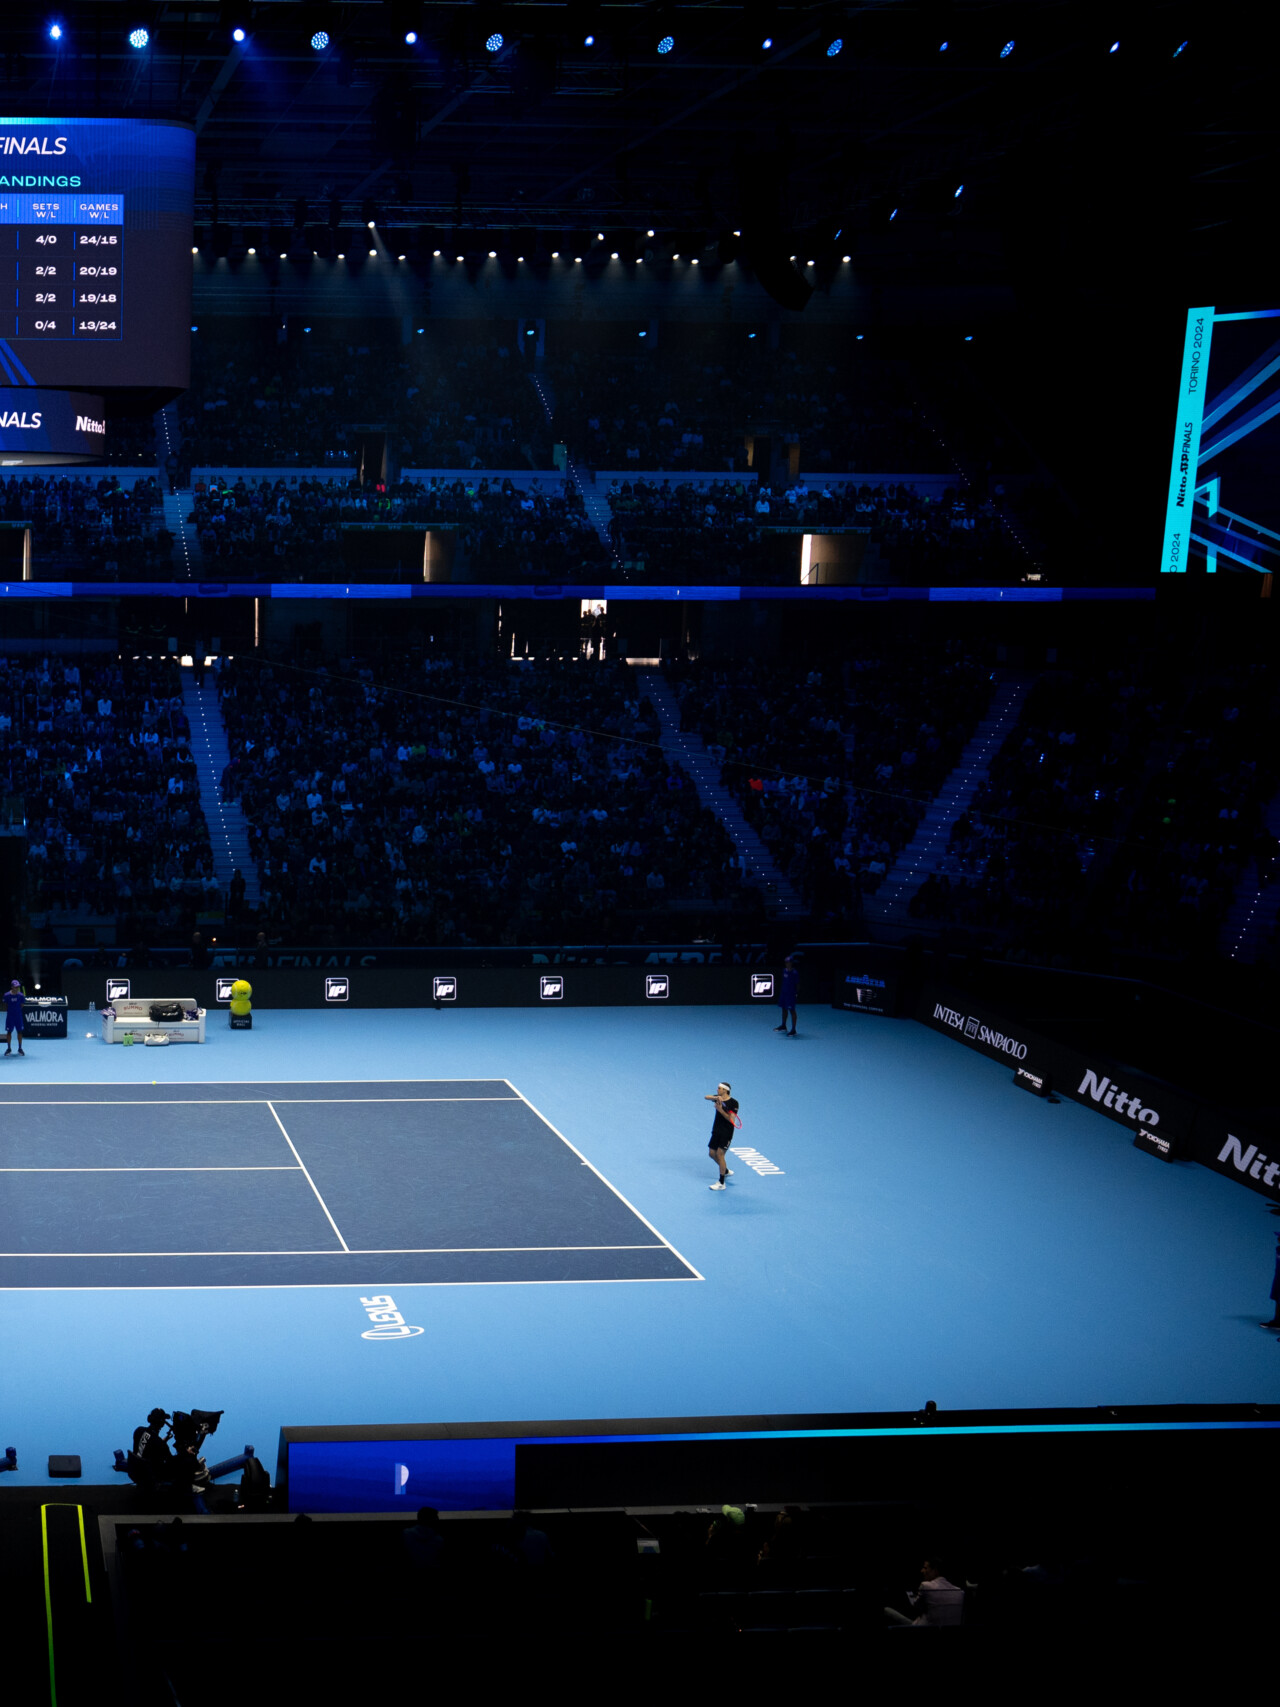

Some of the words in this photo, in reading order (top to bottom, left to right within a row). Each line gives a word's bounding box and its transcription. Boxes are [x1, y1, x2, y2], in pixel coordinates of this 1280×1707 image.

[80, 203, 119, 211] GAMES
[36, 211, 56, 219] W/L
[89, 211, 109, 220] W/L
[35, 235, 57, 246] 4/0
[79, 235, 117, 246] 24/15
[35, 265, 57, 277] 2/2
[79, 266, 117, 277] 20/19
[35, 293, 56, 304] 2/2
[79, 293, 117, 304] 19/18
[35, 320, 56, 331] 0/4
[79, 320, 117, 332] 13/24
[1193, 317, 1204, 349] 2024
[1189, 351, 1201, 395] TORINO
[76, 415, 102, 433] Nitto
[1183, 422, 1193, 454] FINALS
[1180, 453, 1189, 476] ATP
[1176, 476, 1188, 507] Nitto
[1171, 533, 1181, 562] 2024
[25, 1010, 64, 1023] VALMORA
[933, 1003, 965, 1031] INTESA
[977, 1025, 1028, 1060] SANPAOLO
[1077, 1069, 1160, 1126] Nitto
[730, 1147, 786, 1177] TORINO
[1217, 1133, 1280, 1189] Nit
